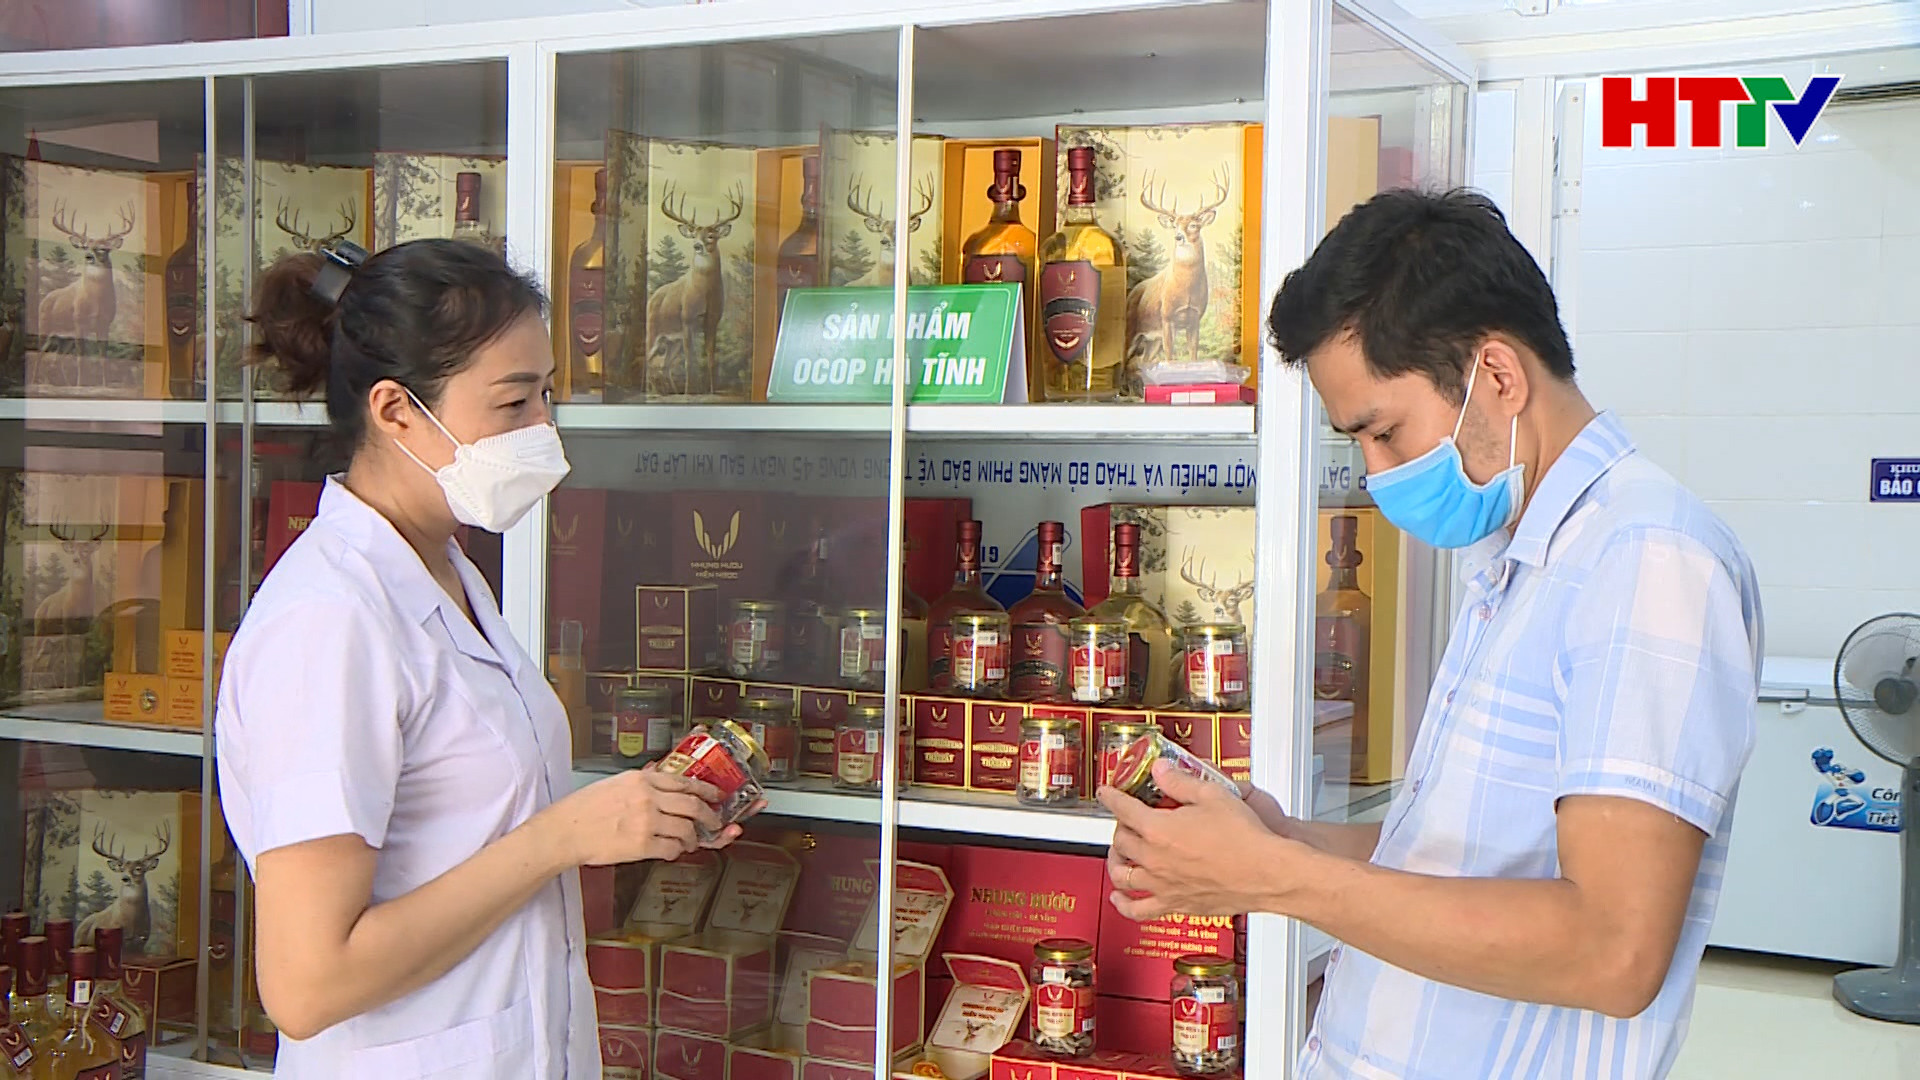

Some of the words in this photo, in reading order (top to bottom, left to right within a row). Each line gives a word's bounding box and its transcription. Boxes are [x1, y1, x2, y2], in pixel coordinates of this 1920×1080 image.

[822, 302, 880, 339] SẢN
[793, 357, 866, 385] OCOP
[922, 351, 986, 385] TĨNH
[978, 460, 1013, 483] PHIM
[1880, 474, 1913, 495] BẢO
[970, 887, 1026, 907] NHUNG
